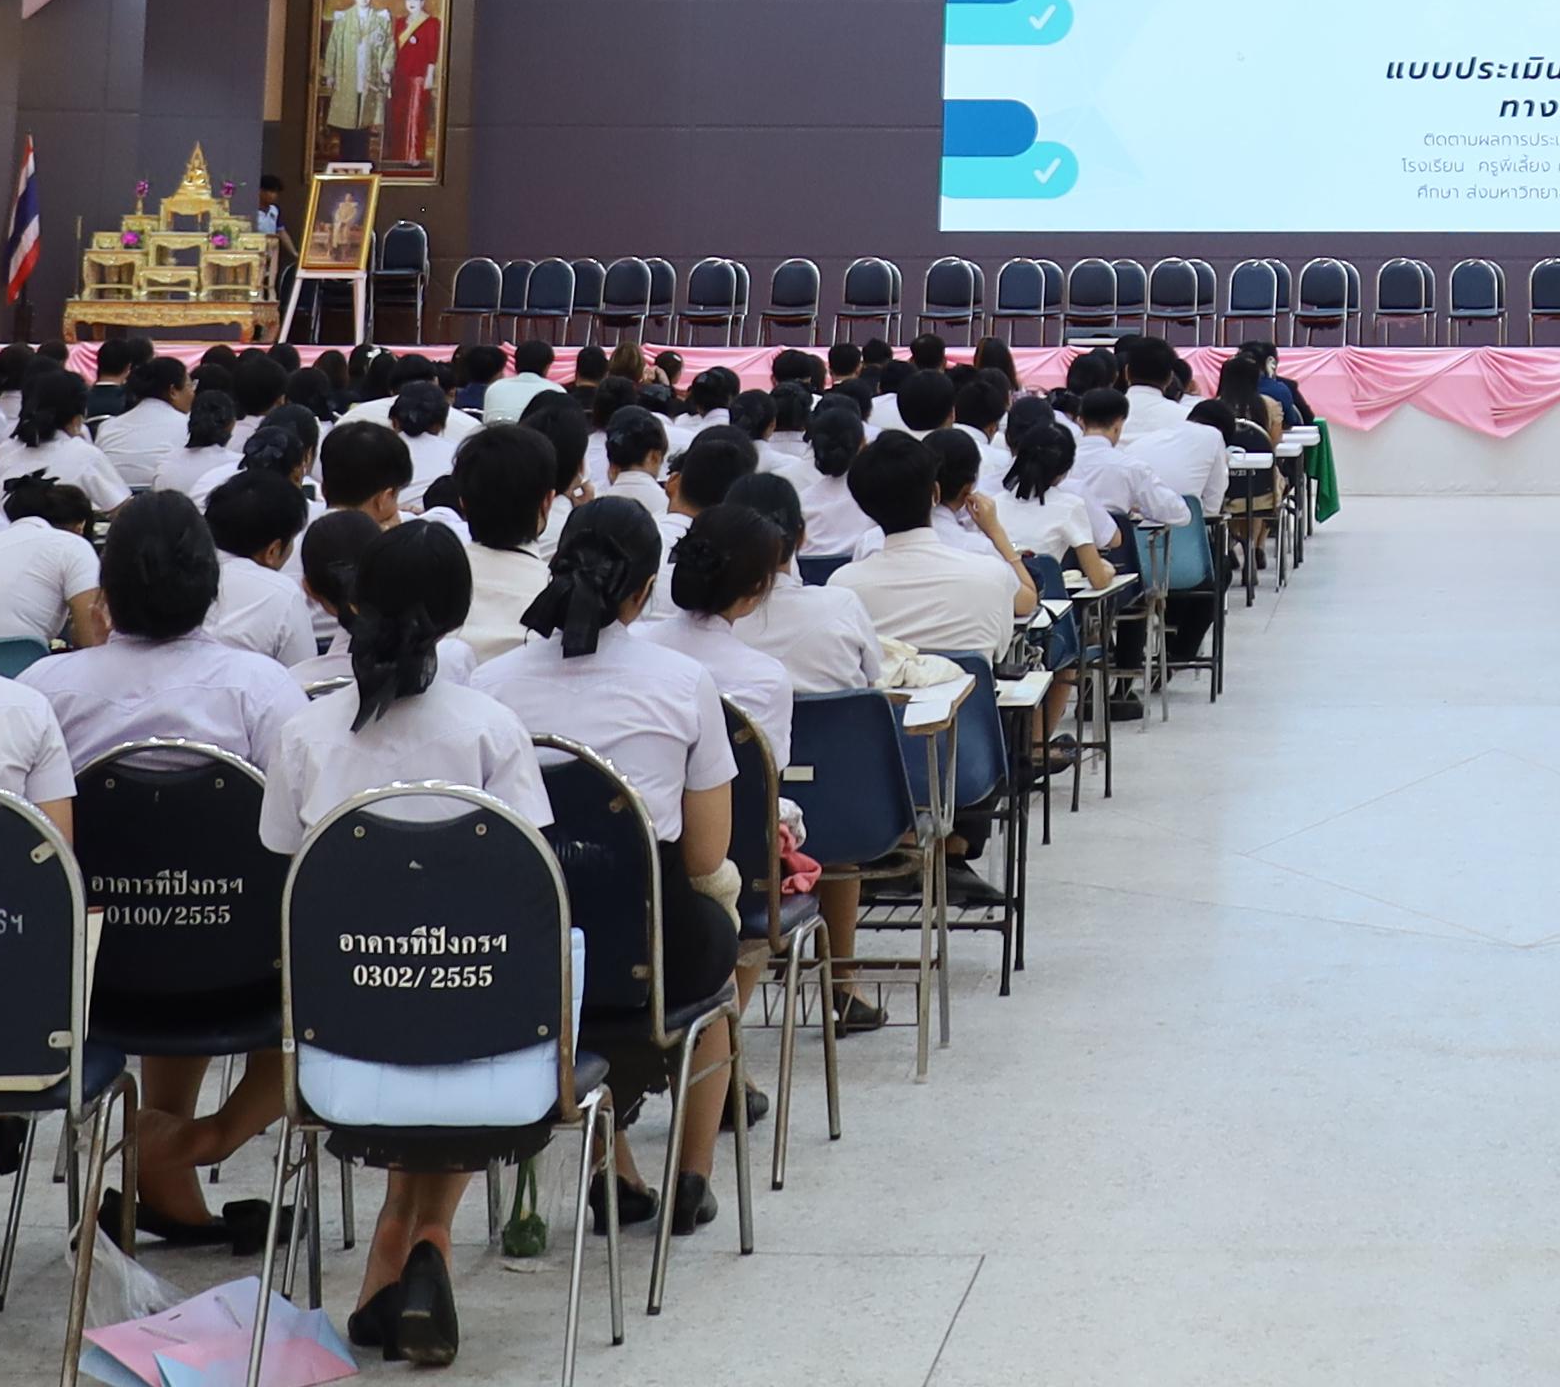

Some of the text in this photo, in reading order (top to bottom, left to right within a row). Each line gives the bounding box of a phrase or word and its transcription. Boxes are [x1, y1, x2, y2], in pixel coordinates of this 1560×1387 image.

[1401, 157, 1464, 172] โรงเรียน
[92, 869, 243, 895] อาคารทีปังกรฯ
[107, 905, 231, 925] 0100/2555
[339, 925, 508, 955] อาคารทีปังกรฯ
